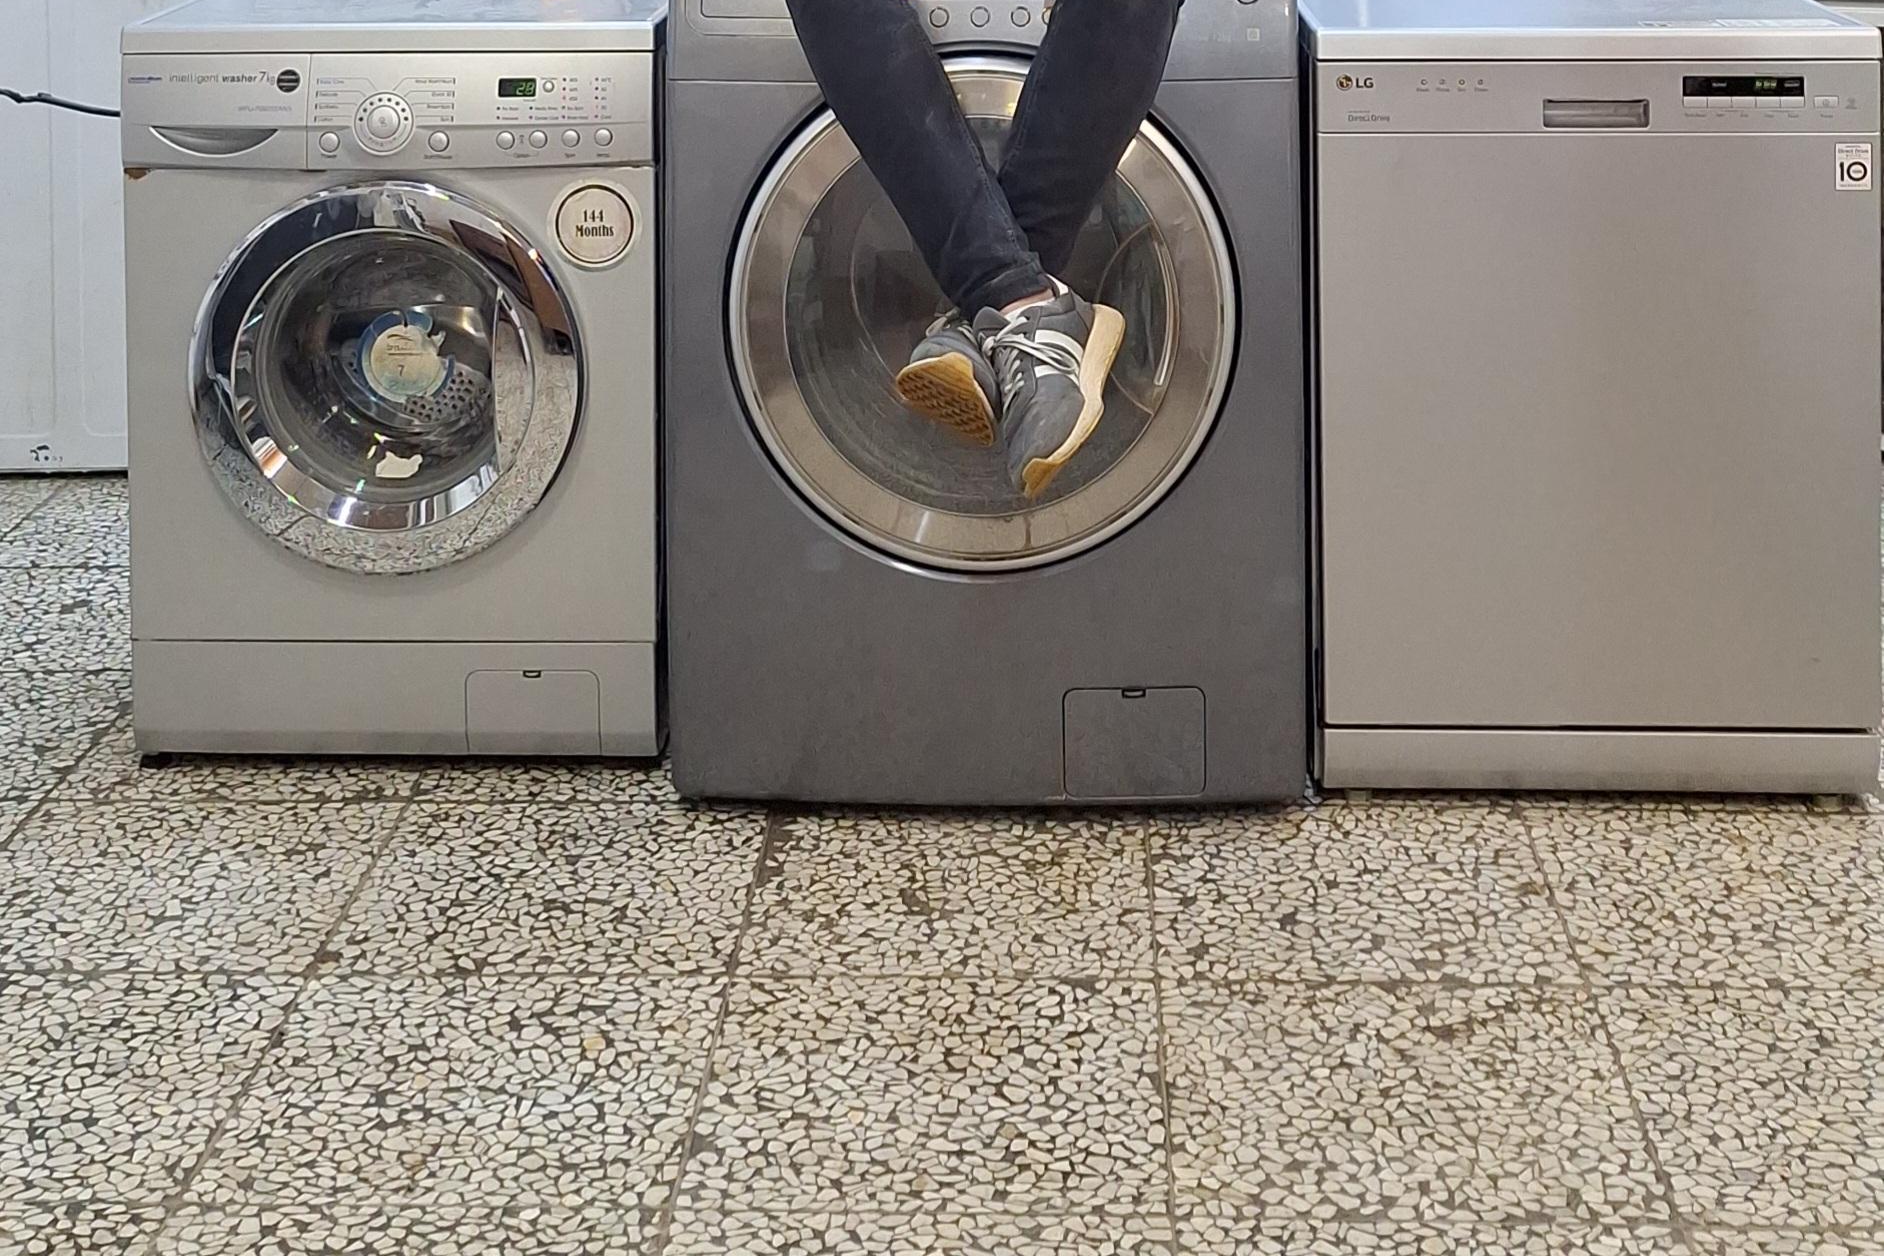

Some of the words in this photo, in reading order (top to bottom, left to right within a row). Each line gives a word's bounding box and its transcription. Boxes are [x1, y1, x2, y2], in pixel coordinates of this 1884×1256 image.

[169, 71, 218, 84] intelligent
[222, 73, 257, 83] washer
[1355, 77, 1374, 89] LG
[515, 82, 535, 95] 28
[1840, 161, 1867, 181] 10
[583, 209, 604, 222] 144
[575, 224, 615, 237] Months
